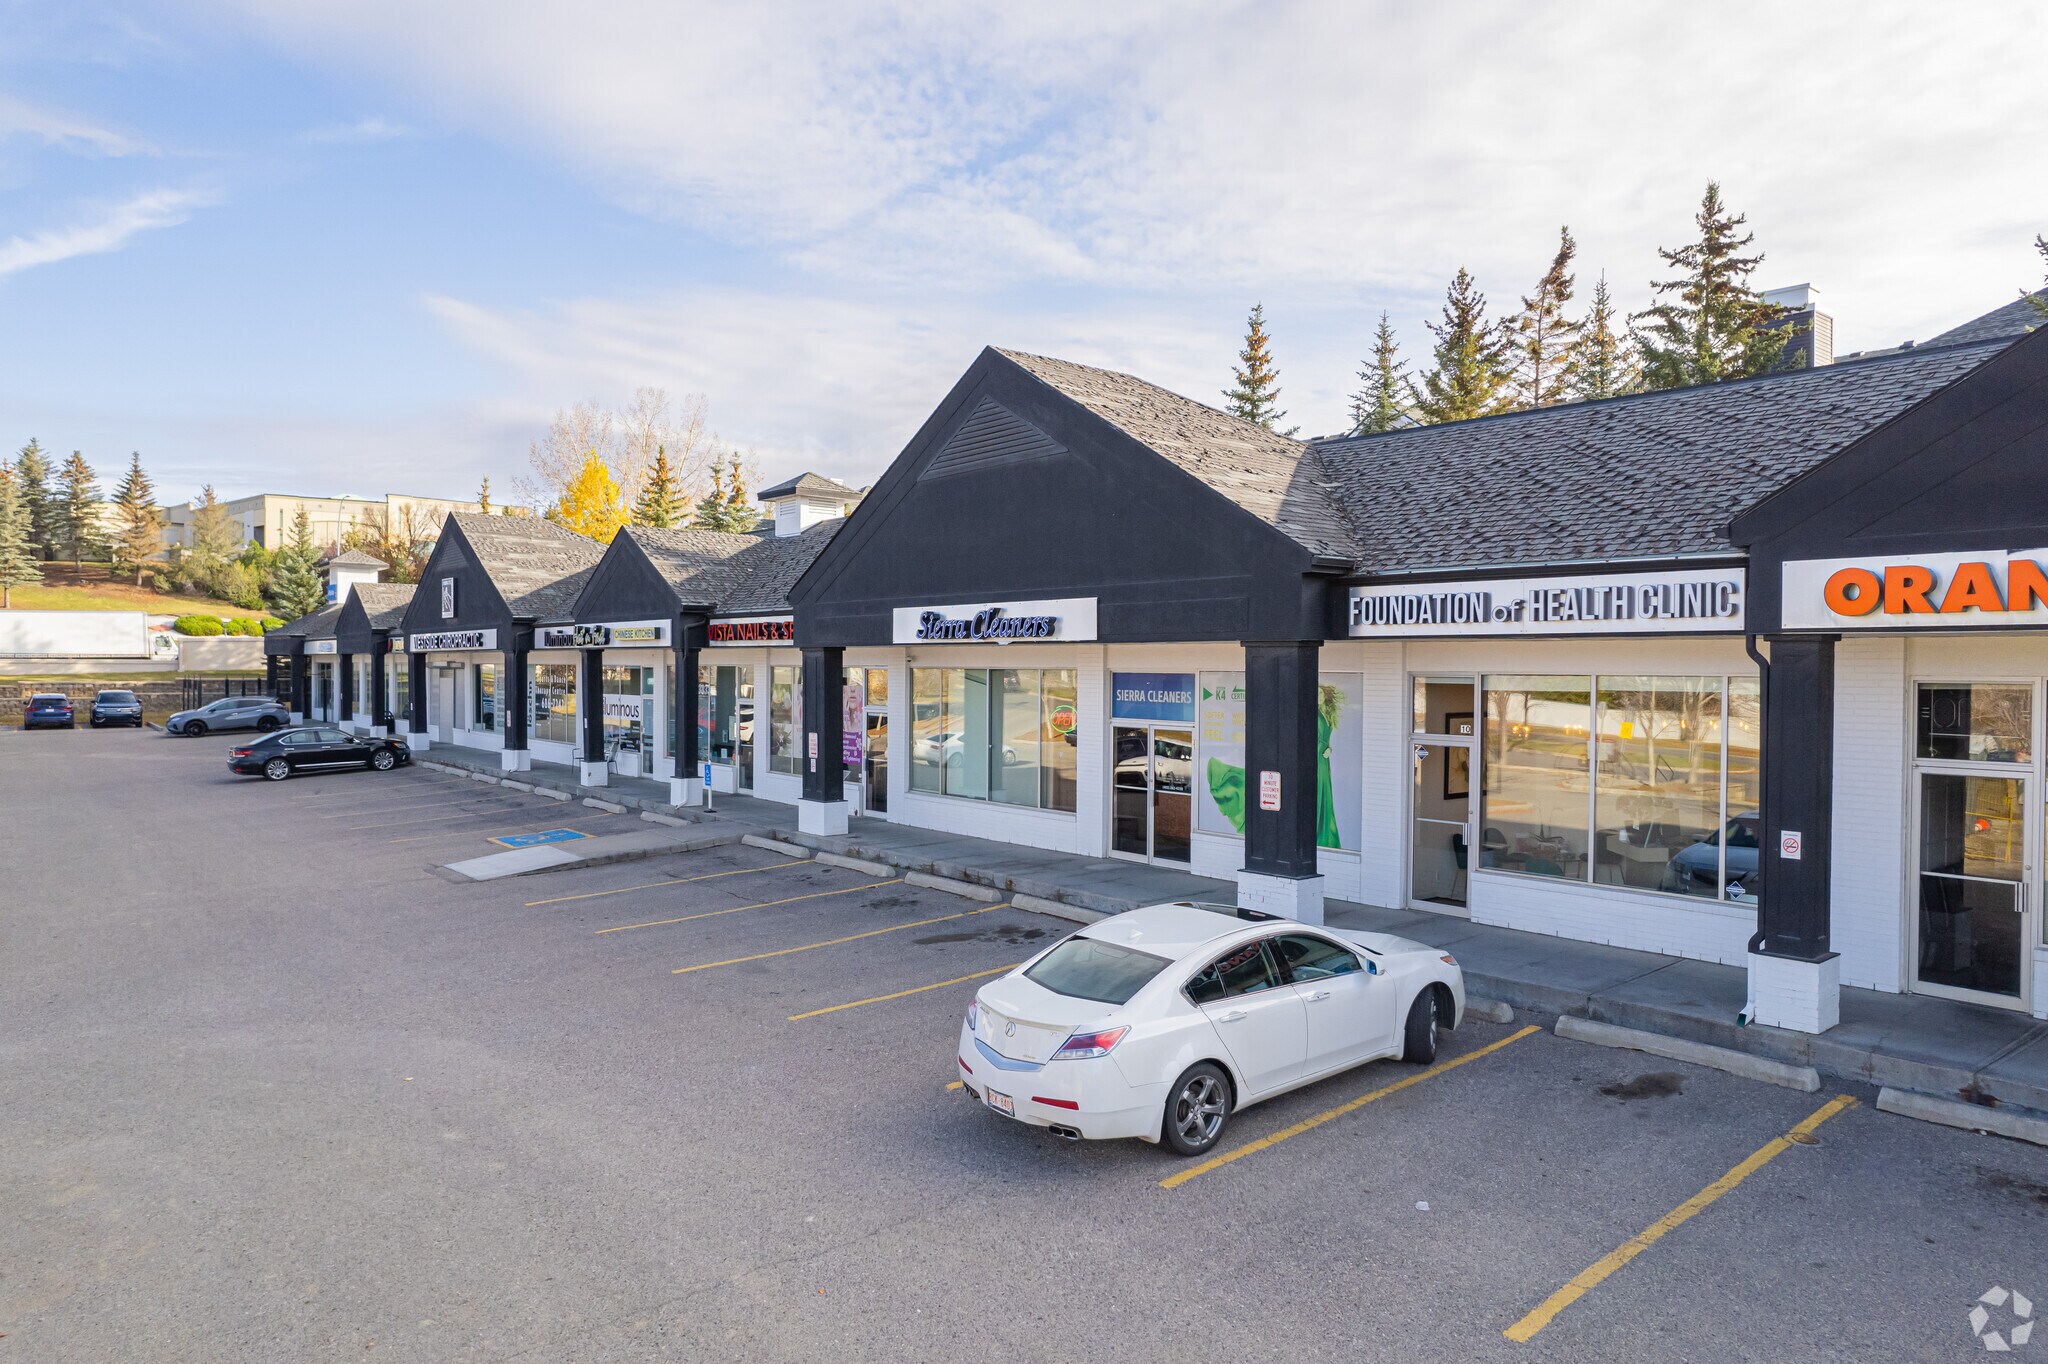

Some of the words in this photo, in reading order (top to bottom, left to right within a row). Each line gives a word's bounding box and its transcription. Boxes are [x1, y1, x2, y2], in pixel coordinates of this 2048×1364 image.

[1824, 559, 2048, 617] ORAN
[1350, 591, 1486, 626] FOUNDATION
[1492, 599, 1522, 623] of
[1529, 585, 1630, 622] HEALTH
[1638, 581, 1735, 619] CLINIC
[707, 623, 735, 641] VISTA
[737, 621, 769, 641] NAILS
[771, 621, 779, 641] &
[915, 610, 966, 640] Sierra
[970, 607, 1051, 640] Cleaners
[413, 635, 438, 650] WESTSIDE
[438, 632, 481, 649] CHIROPRACTIC
[614, 630, 634, 640] CHINESE
[634, 628, 655, 639] KITCHEN
[1116, 689, 1146, 702] SIERRA
[1147, 690, 1192, 704] CLEANERS
[1215, 690, 1226, 701] K4
[1461, 725, 1471, 733] 10
